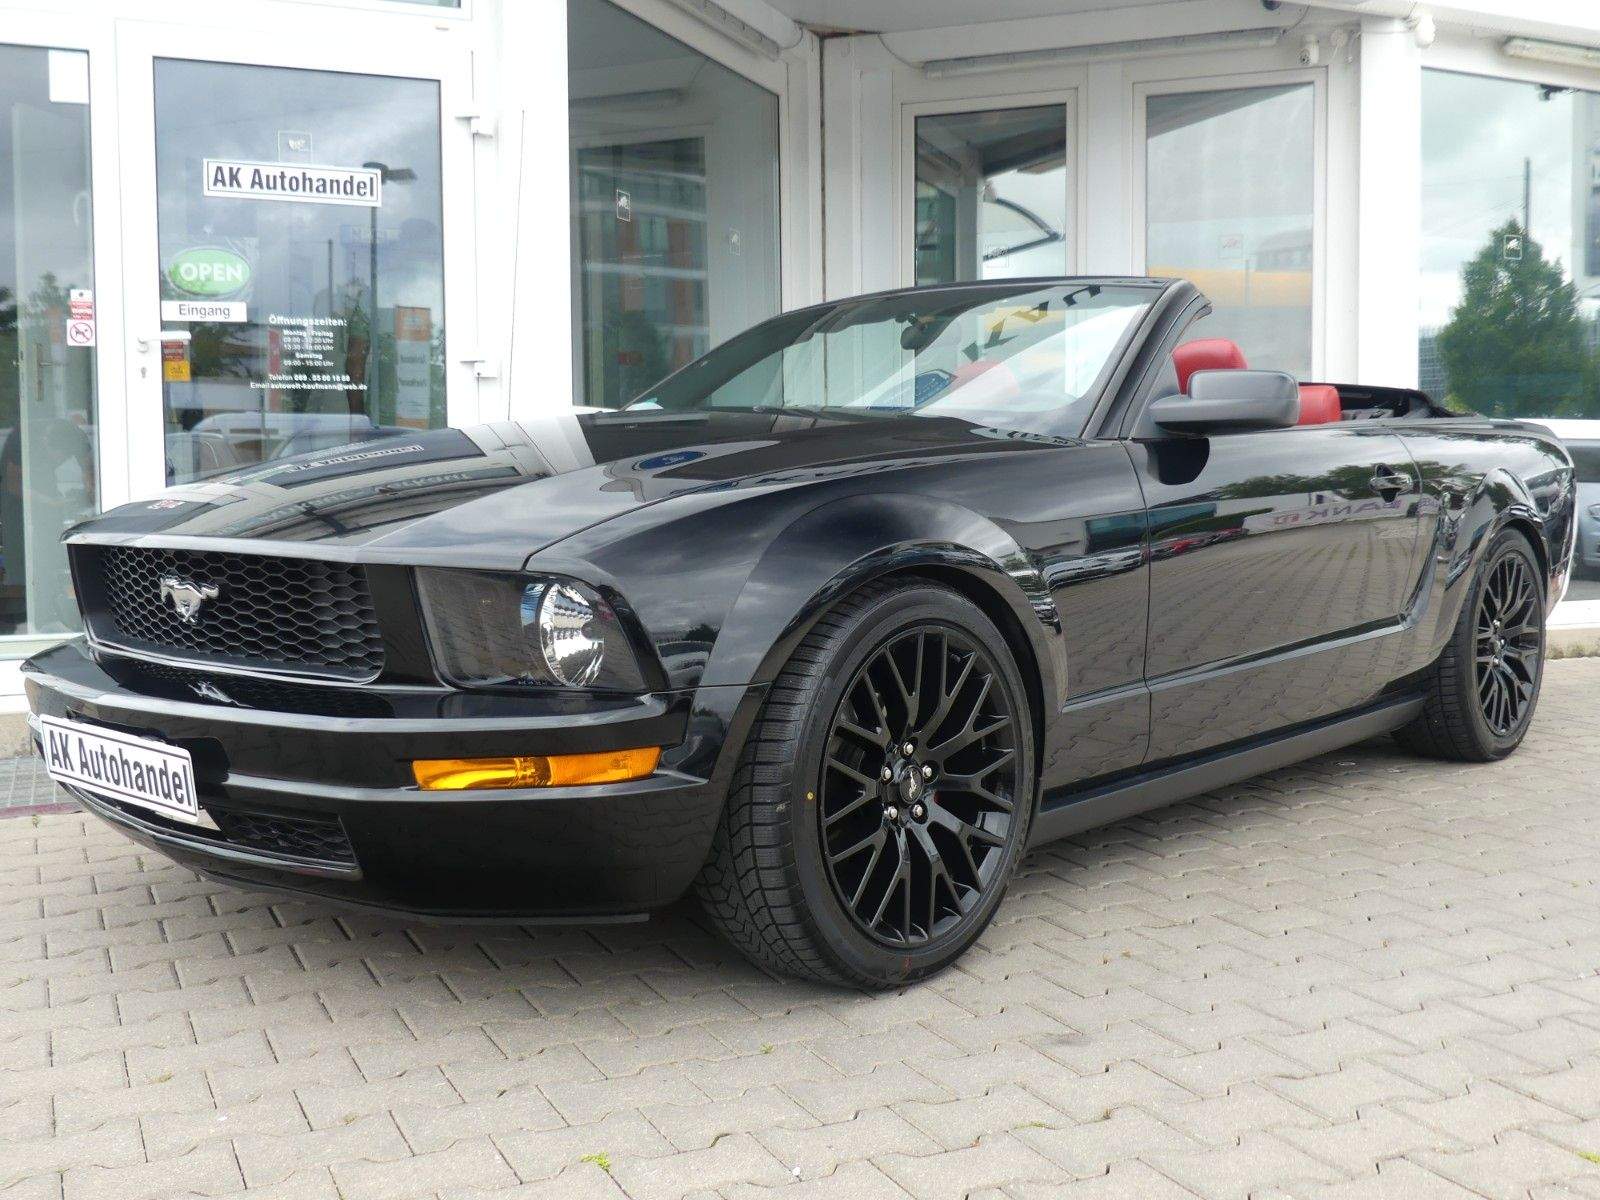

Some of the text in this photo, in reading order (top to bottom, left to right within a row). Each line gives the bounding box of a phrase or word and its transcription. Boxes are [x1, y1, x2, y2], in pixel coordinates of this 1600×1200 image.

[212, 165, 375, 197] AK Autohandel
[179, 262, 243, 282] OPEN
[178, 303, 231, 320] Eingang
[268, 314, 348, 327] Öffnungszeiten:
[49, 729, 192, 807] AK Autohandel
